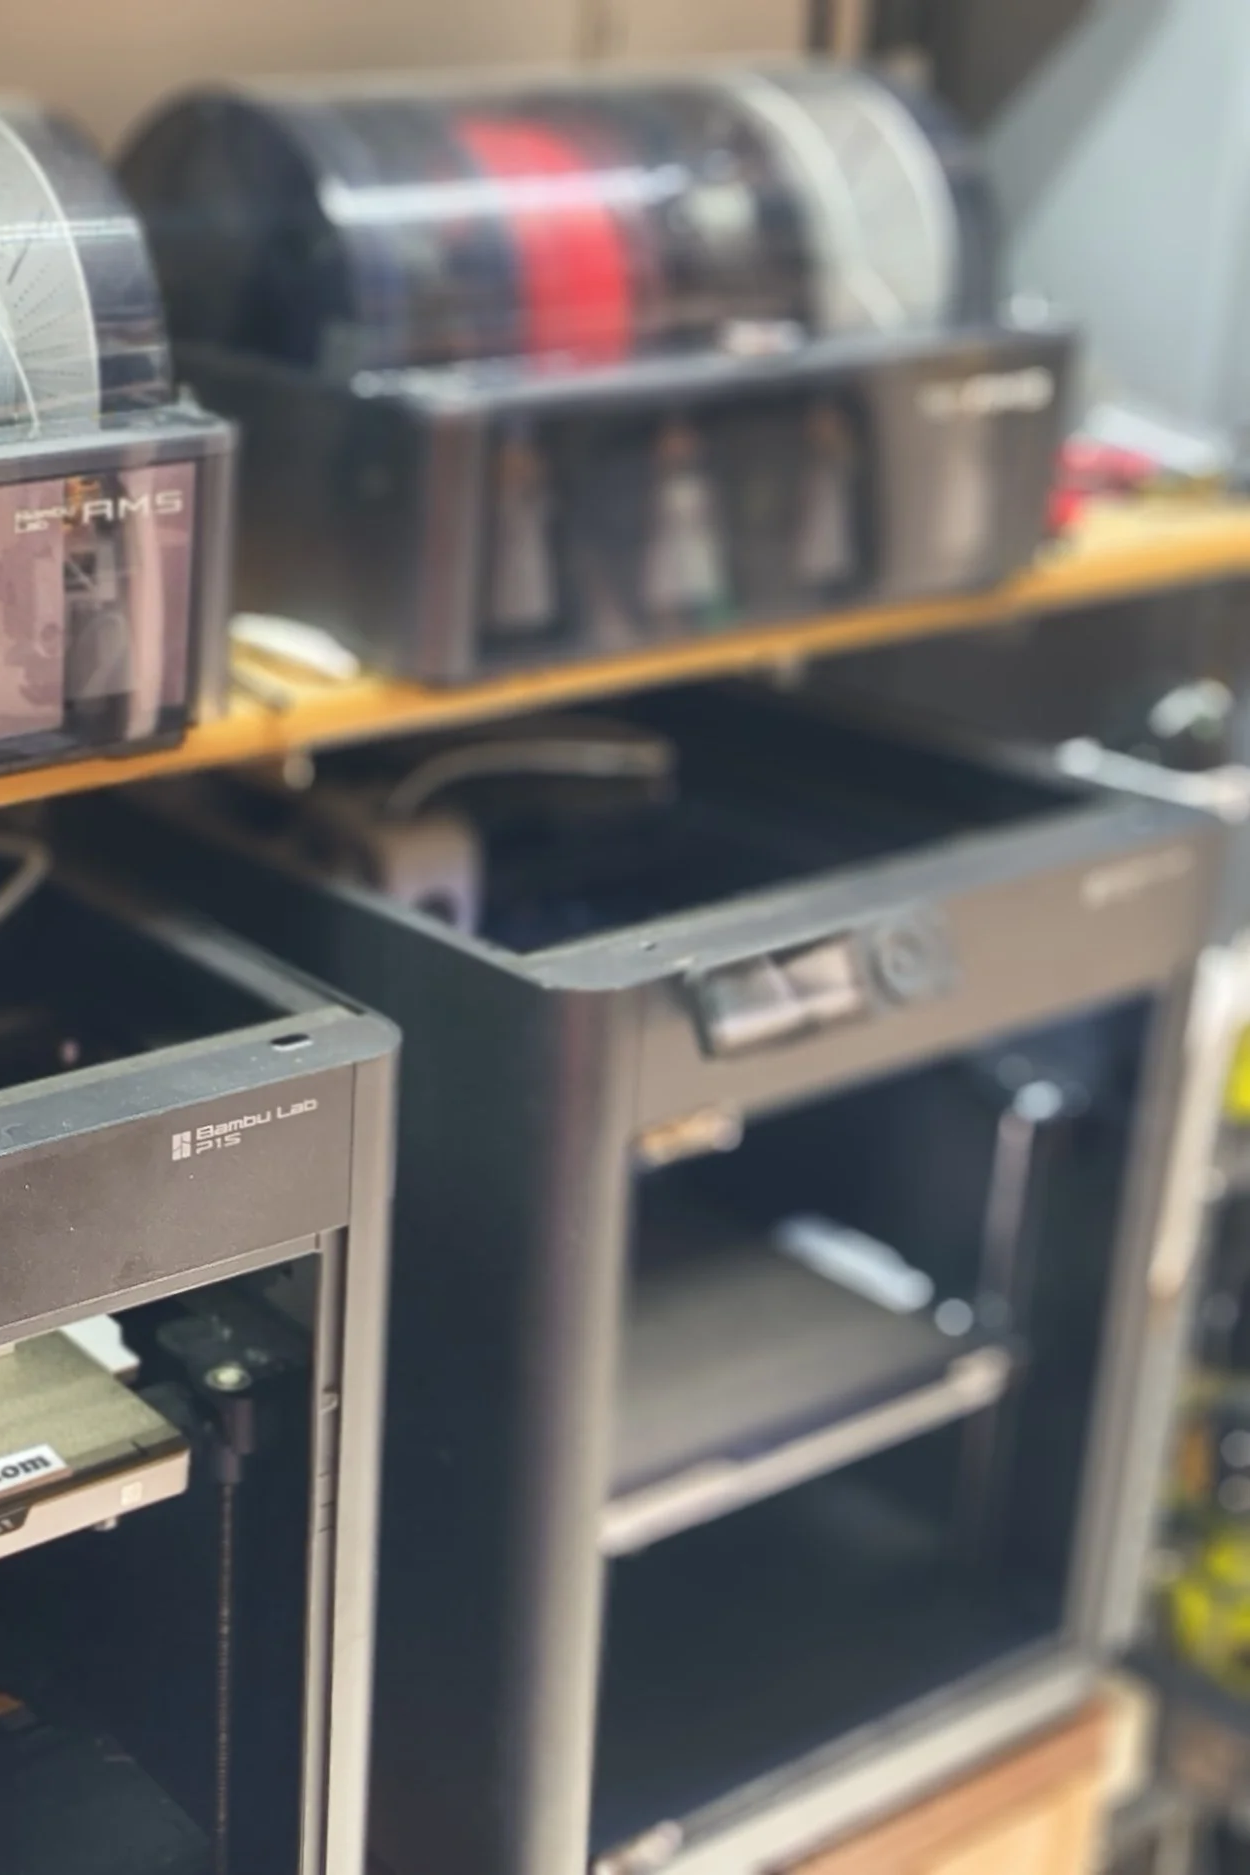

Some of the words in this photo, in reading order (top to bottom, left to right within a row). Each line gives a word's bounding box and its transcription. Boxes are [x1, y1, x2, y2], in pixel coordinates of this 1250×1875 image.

[82, 490, 183, 525] AMS
[196, 1111, 271, 1141] Bambu
[277, 1098, 318, 1119] Lab
[196, 1132, 241, 1154] P1S
